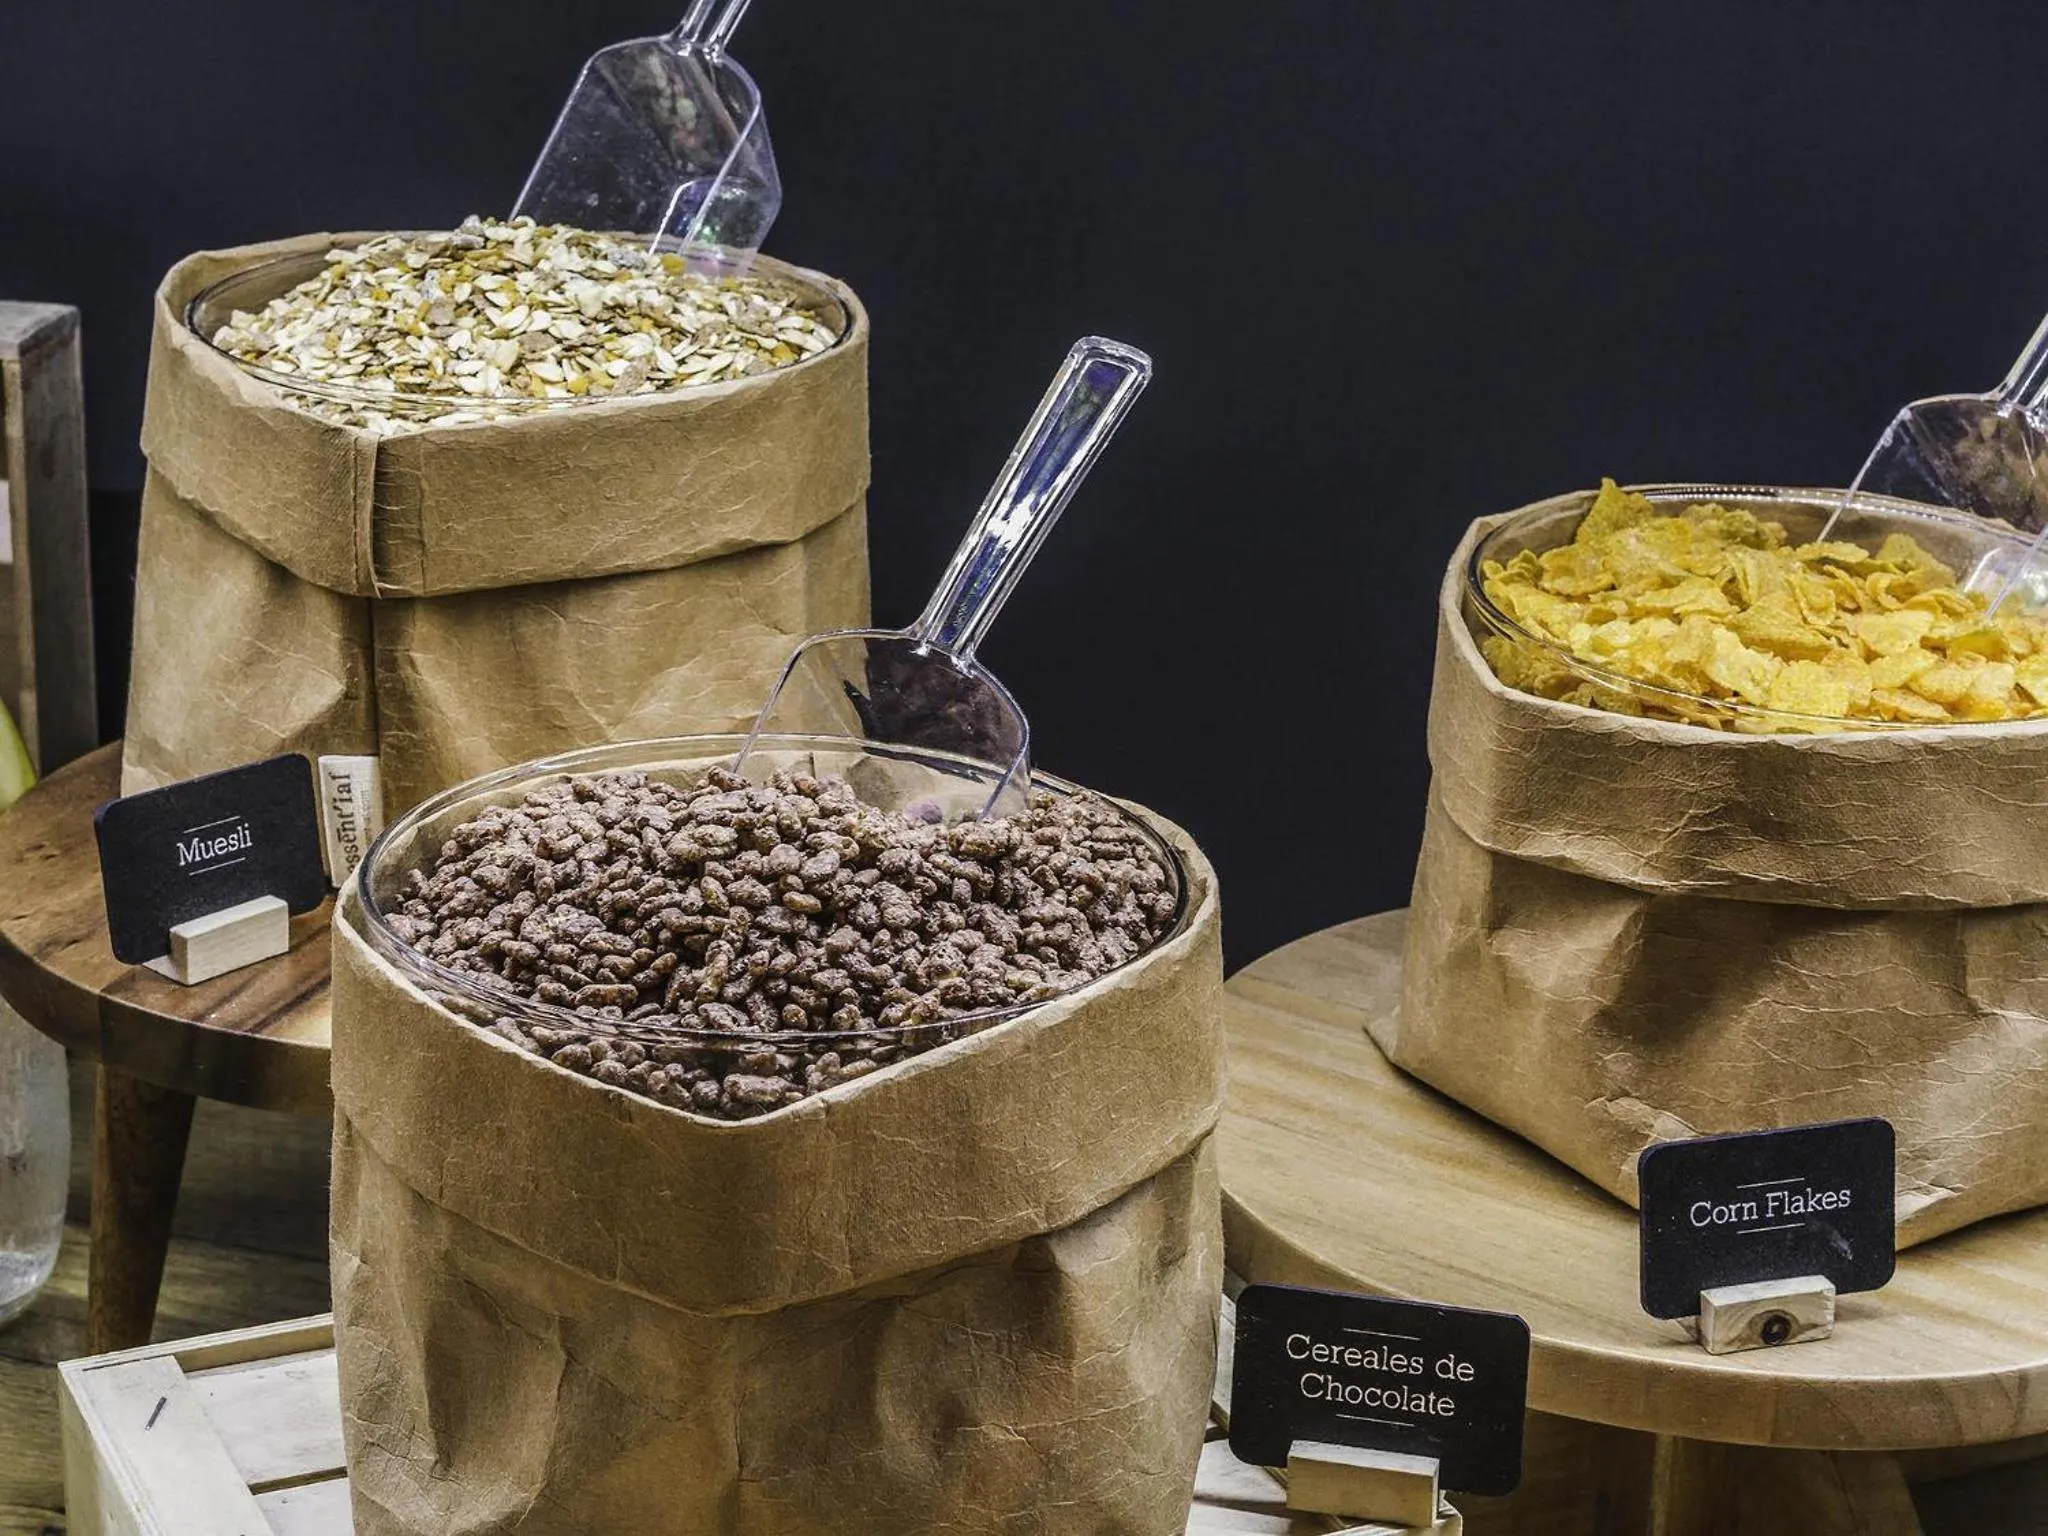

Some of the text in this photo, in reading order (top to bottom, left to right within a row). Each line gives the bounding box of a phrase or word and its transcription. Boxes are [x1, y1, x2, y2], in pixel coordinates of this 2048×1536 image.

[176, 823, 253, 866] Muesli
[1690, 1188, 1851, 1227] Corn Flakes
[1286, 1333, 1475, 1382] Cereales de
[1300, 1372, 1456, 1417] Chocolate
